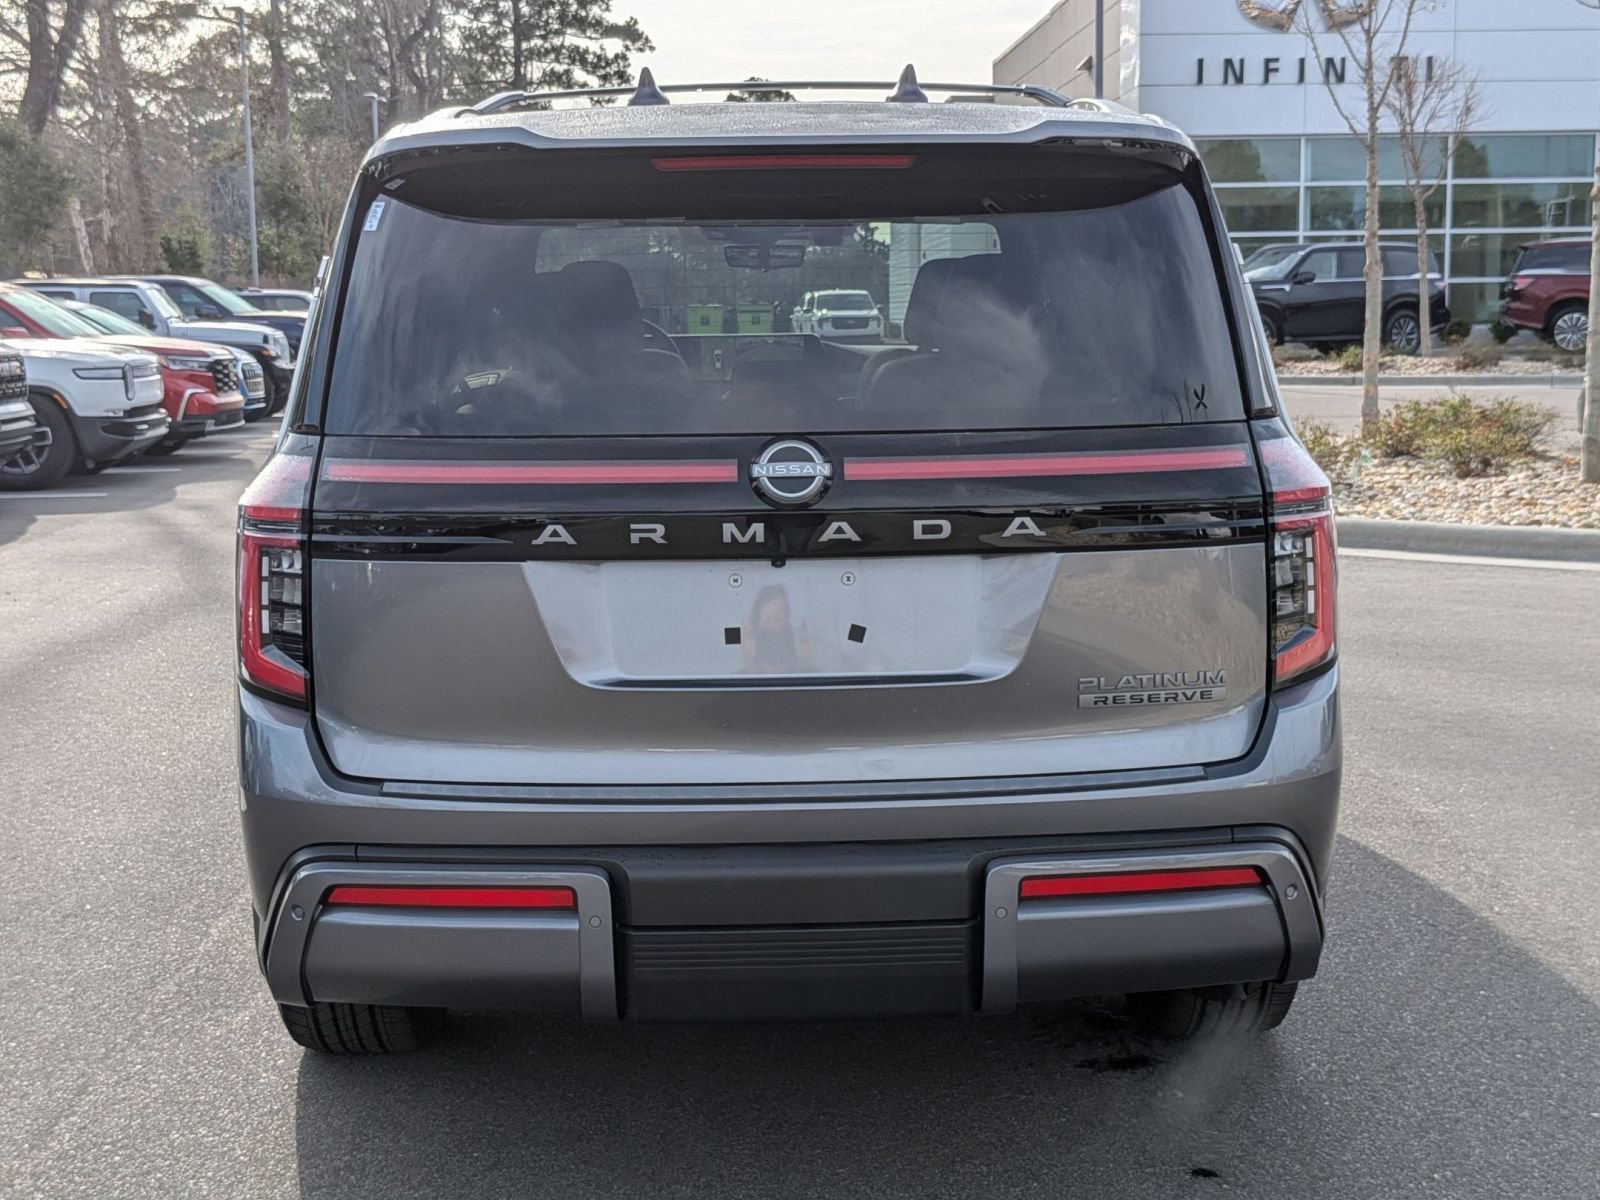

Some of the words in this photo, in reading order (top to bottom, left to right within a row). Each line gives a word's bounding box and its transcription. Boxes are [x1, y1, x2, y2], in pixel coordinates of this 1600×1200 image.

[1196, 56, 1433, 85] INFINTI
[754, 464, 829, 476] NISSAN
[531, 516, 1046, 545] ARMADA
[1078, 670, 1226, 691] PLATINUM
[1093, 689, 1213, 706] RESERVE
